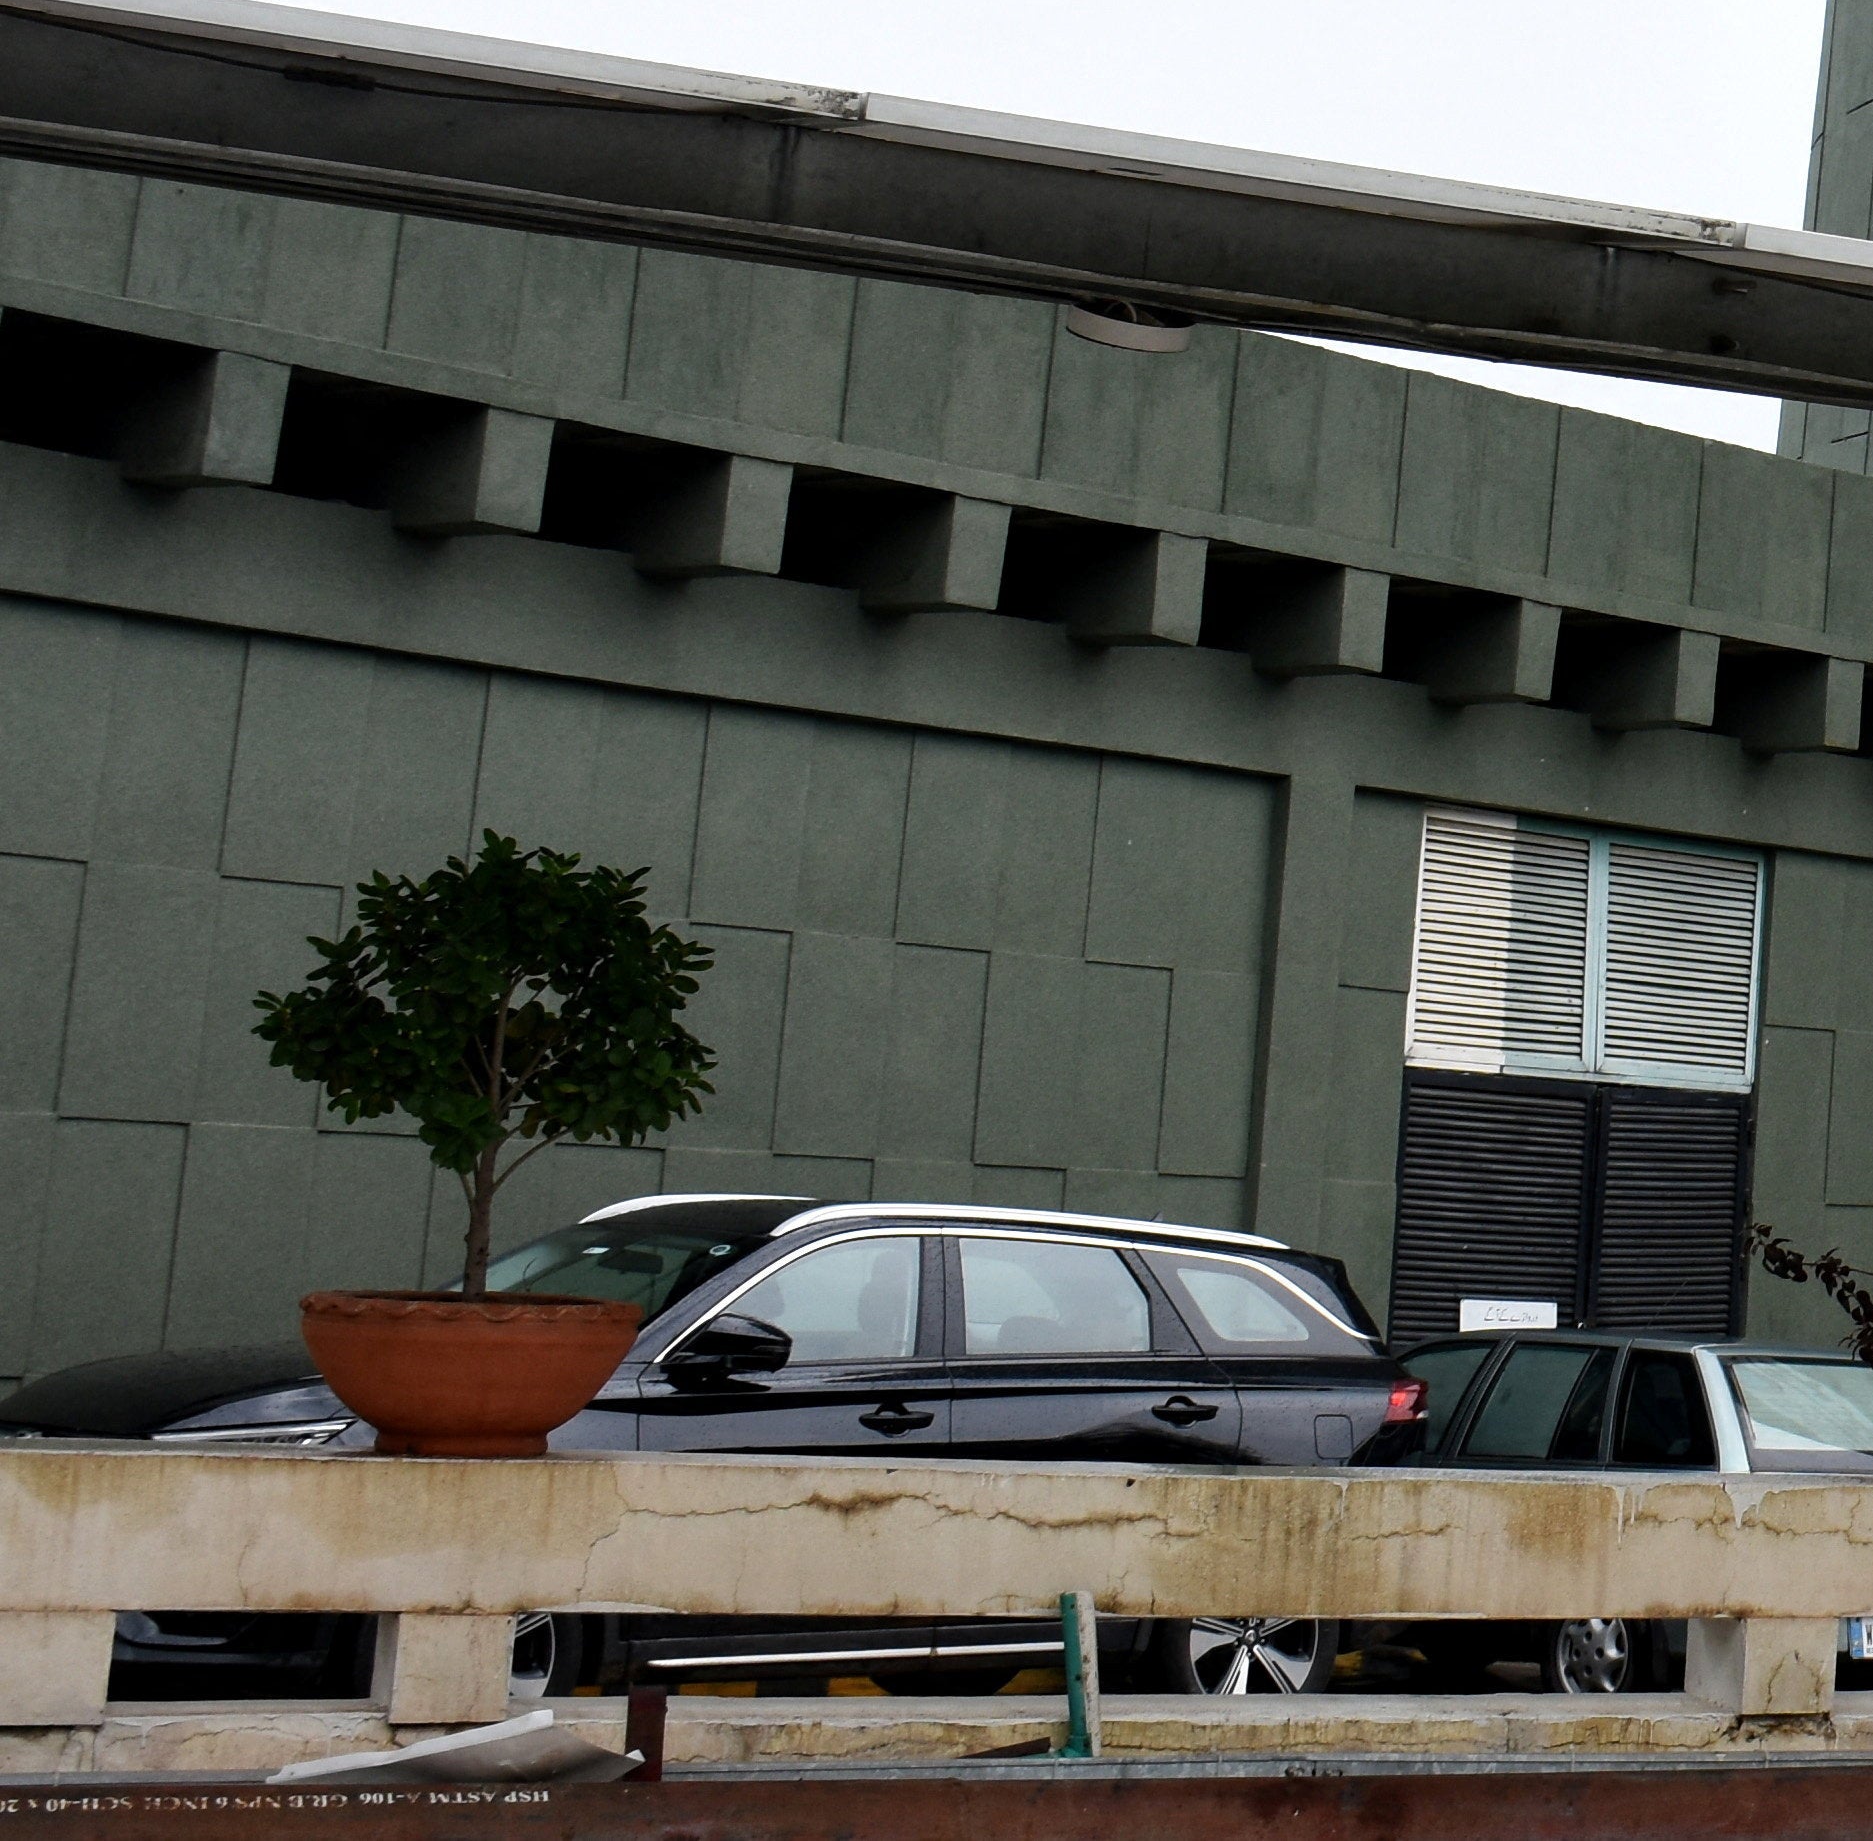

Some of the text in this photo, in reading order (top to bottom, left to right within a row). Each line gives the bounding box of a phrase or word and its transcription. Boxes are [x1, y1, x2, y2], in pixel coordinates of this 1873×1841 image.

[215, 1796, 228, 1809] 6
[359, 1792, 421, 1805] A-106
[429, 1791, 496, 1804] ASTM
[503, 1790, 550, 1804] HSP
